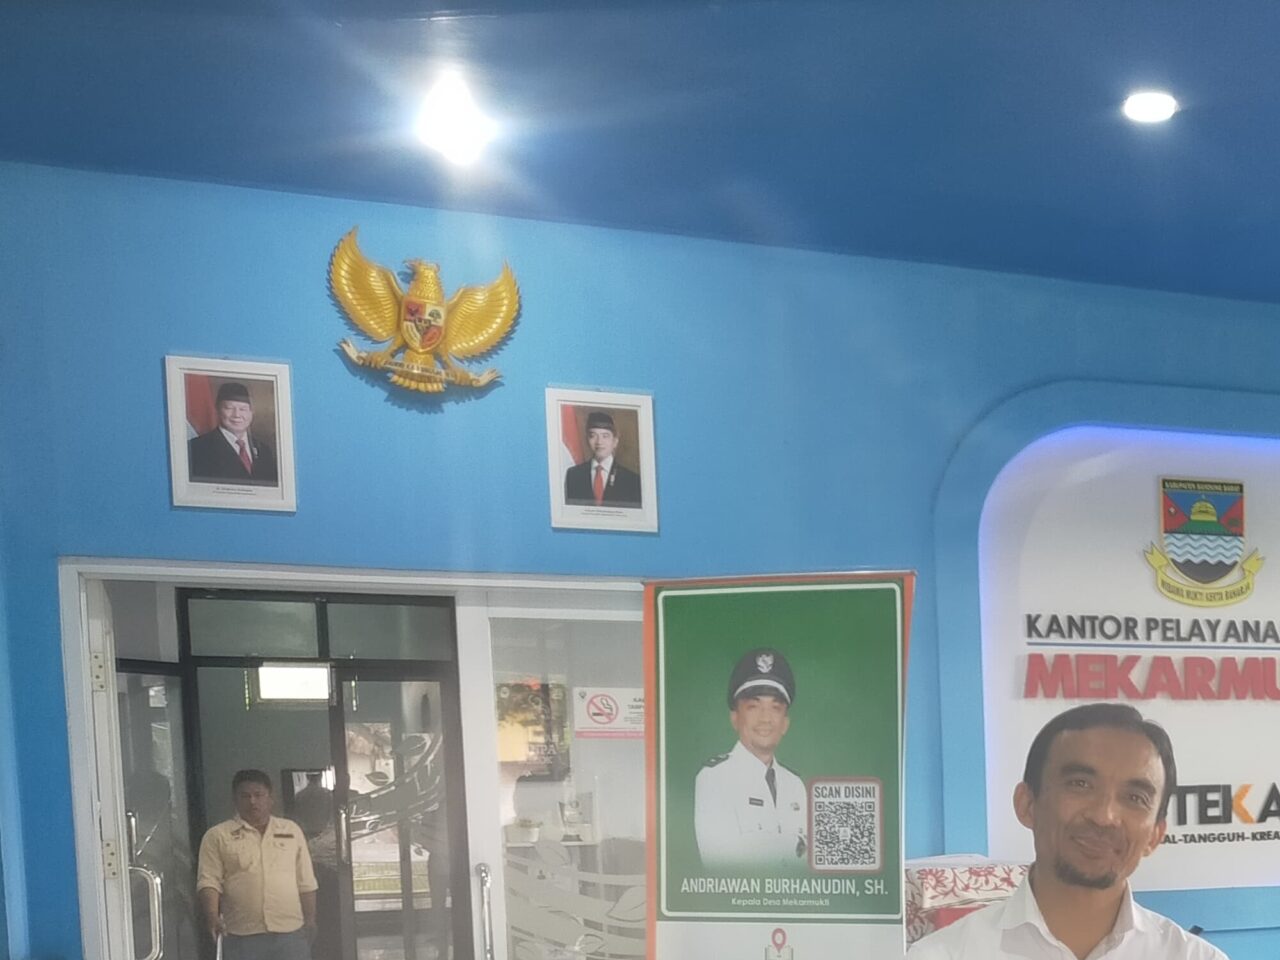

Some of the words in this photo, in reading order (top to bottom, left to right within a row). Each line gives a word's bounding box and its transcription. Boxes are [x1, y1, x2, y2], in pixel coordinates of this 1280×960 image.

[1026, 613, 1139, 641] KANTOR
[814, 785, 841, 798] SCAN
[844, 786, 876, 799] DISINI
[680, 877, 760, 894] ANDRIAWAN
[764, 878, 860, 896] BURHANUDIN,
[864, 879, 889, 895] SH.
[731, 898, 761, 907] Kepala
[762, 898, 781, 906] Desa
[782, 898, 830, 907] Mekarmukti
